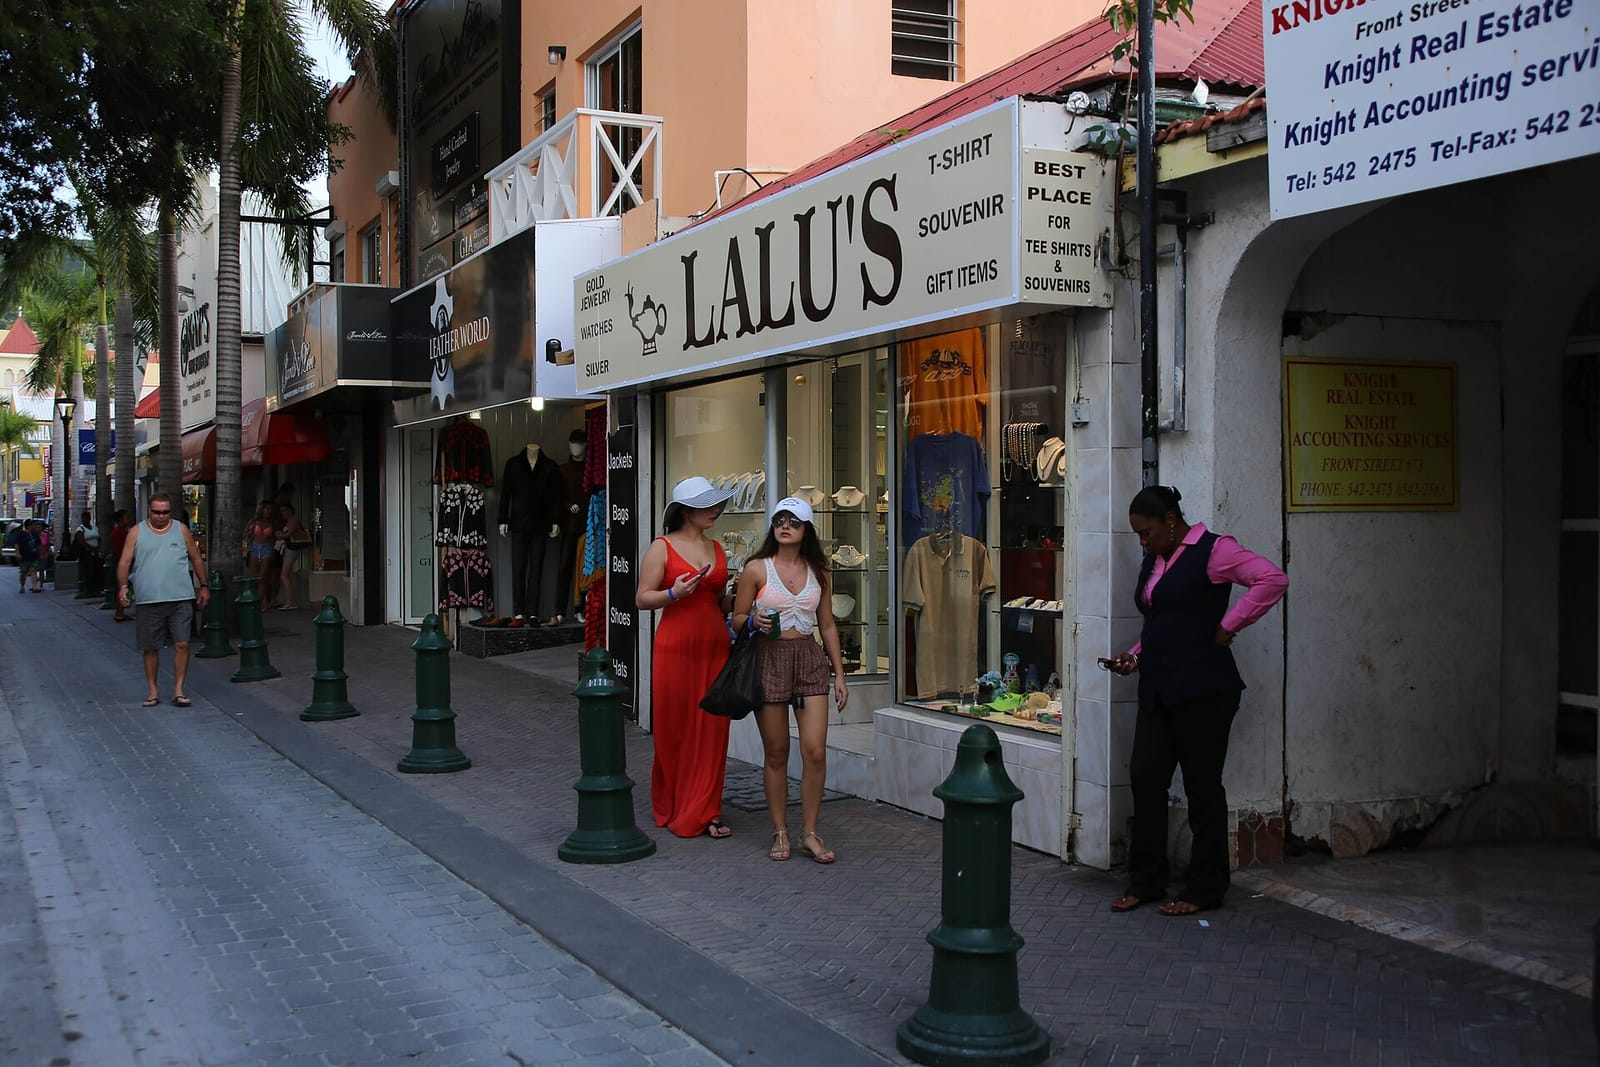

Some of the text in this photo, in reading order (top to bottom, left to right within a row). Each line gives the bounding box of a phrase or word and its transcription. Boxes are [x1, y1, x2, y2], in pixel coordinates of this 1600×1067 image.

[1271, 0, 1377, 35] KNIG
[1355, 0, 1469, 41] Front Stree
[1324, 0, 1573, 89] Knight Real Estate
[1284, 108, 1356, 149] Knight
[1363, 70, 1512, 129] Accounting
[928, 133, 993, 175] T-SHIRT
[1286, 172, 1317, 194] Tel:
[1322, 161, 1356, 186] 542
[1368, 146, 1417, 176] 2475
[1430, 127, 1517, 162] Tel-Fax:
[1525, 109, 1570, 141] 542
[1034, 161, 1086, 179] BEST
[1028, 187, 1091, 205] PLACE
[918, 194, 1004, 238] SOUVENIR
[1048, 215, 1071, 230] FOR
[1026, 239, 1091, 258] TEE SHIRTS
[681, 173, 902, 351] LALU'S
[1054, 259, 1062, 273] &
[585, 275, 605, 293] GOLD
[927, 259, 998, 295] GIFT ITEMS
[1024, 276, 1090, 293] SOUVENIRS
[580, 287, 612, 312] JEWELRY
[429, 316, 490, 360] LEATHER WORLD
[580, 318, 613, 341] WATCHES
[585, 360, 609, 378] SILVER
[1344, 372, 1397, 388] KNIGHT
[1327, 389, 1417, 406] REAL ESTATE
[1344, 415, 1398, 430] KNIGHT
[1292, 431, 1450, 448] ACCOUNTING SERVICES
[608, 452, 633, 469] Jackets
[1322, 457, 1362, 473] FRONT
[1300, 482, 1344, 497] PHONE:
[612, 504, 629, 525] Bags
[612, 555, 629, 574] Belts
[610, 606, 631, 626] Shoes
